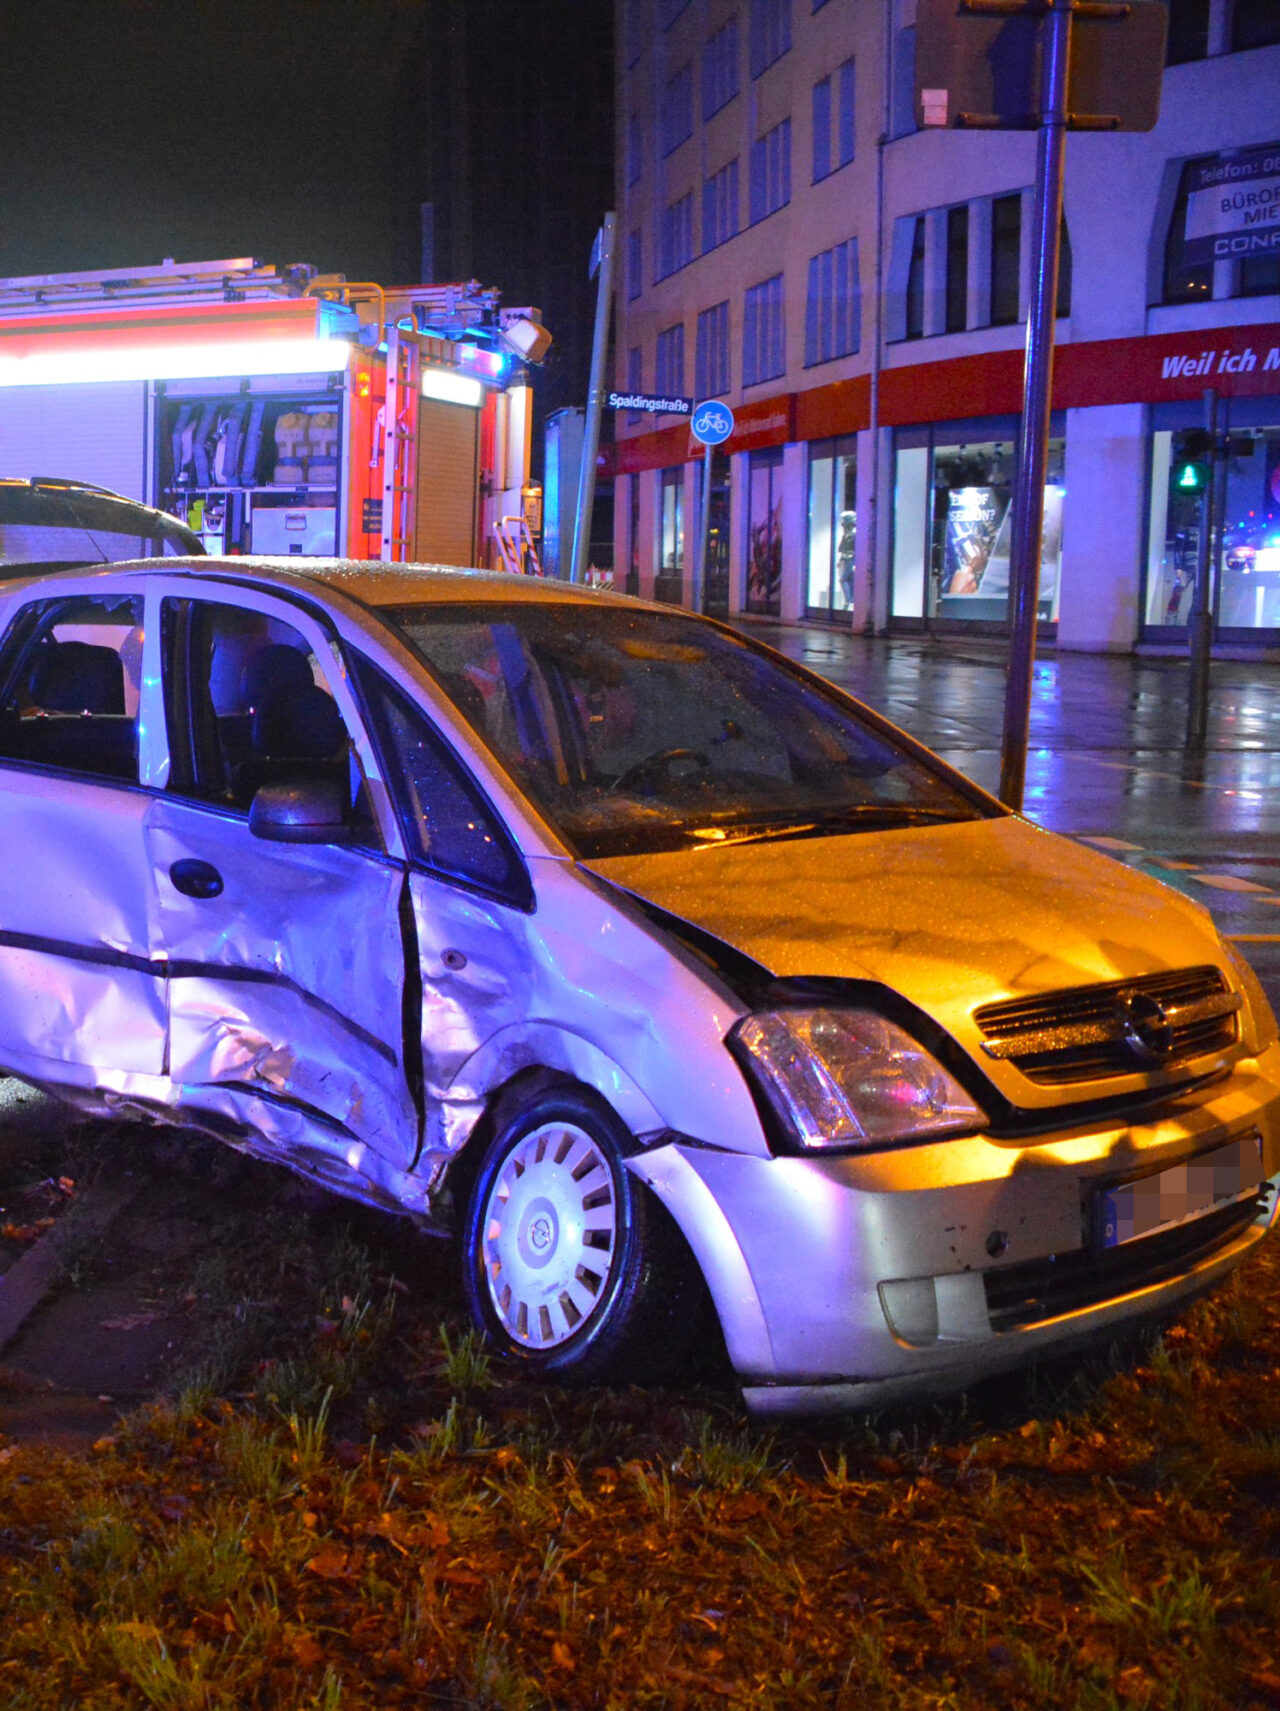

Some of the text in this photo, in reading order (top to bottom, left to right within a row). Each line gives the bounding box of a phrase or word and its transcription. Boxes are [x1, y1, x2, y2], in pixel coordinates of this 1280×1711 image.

[1201, 163, 1259, 182] Telefon:
[1161, 350, 1216, 379] Weil
[1217, 347, 1257, 374] ich
[609, 393, 689, 412] Spaldingstraße
